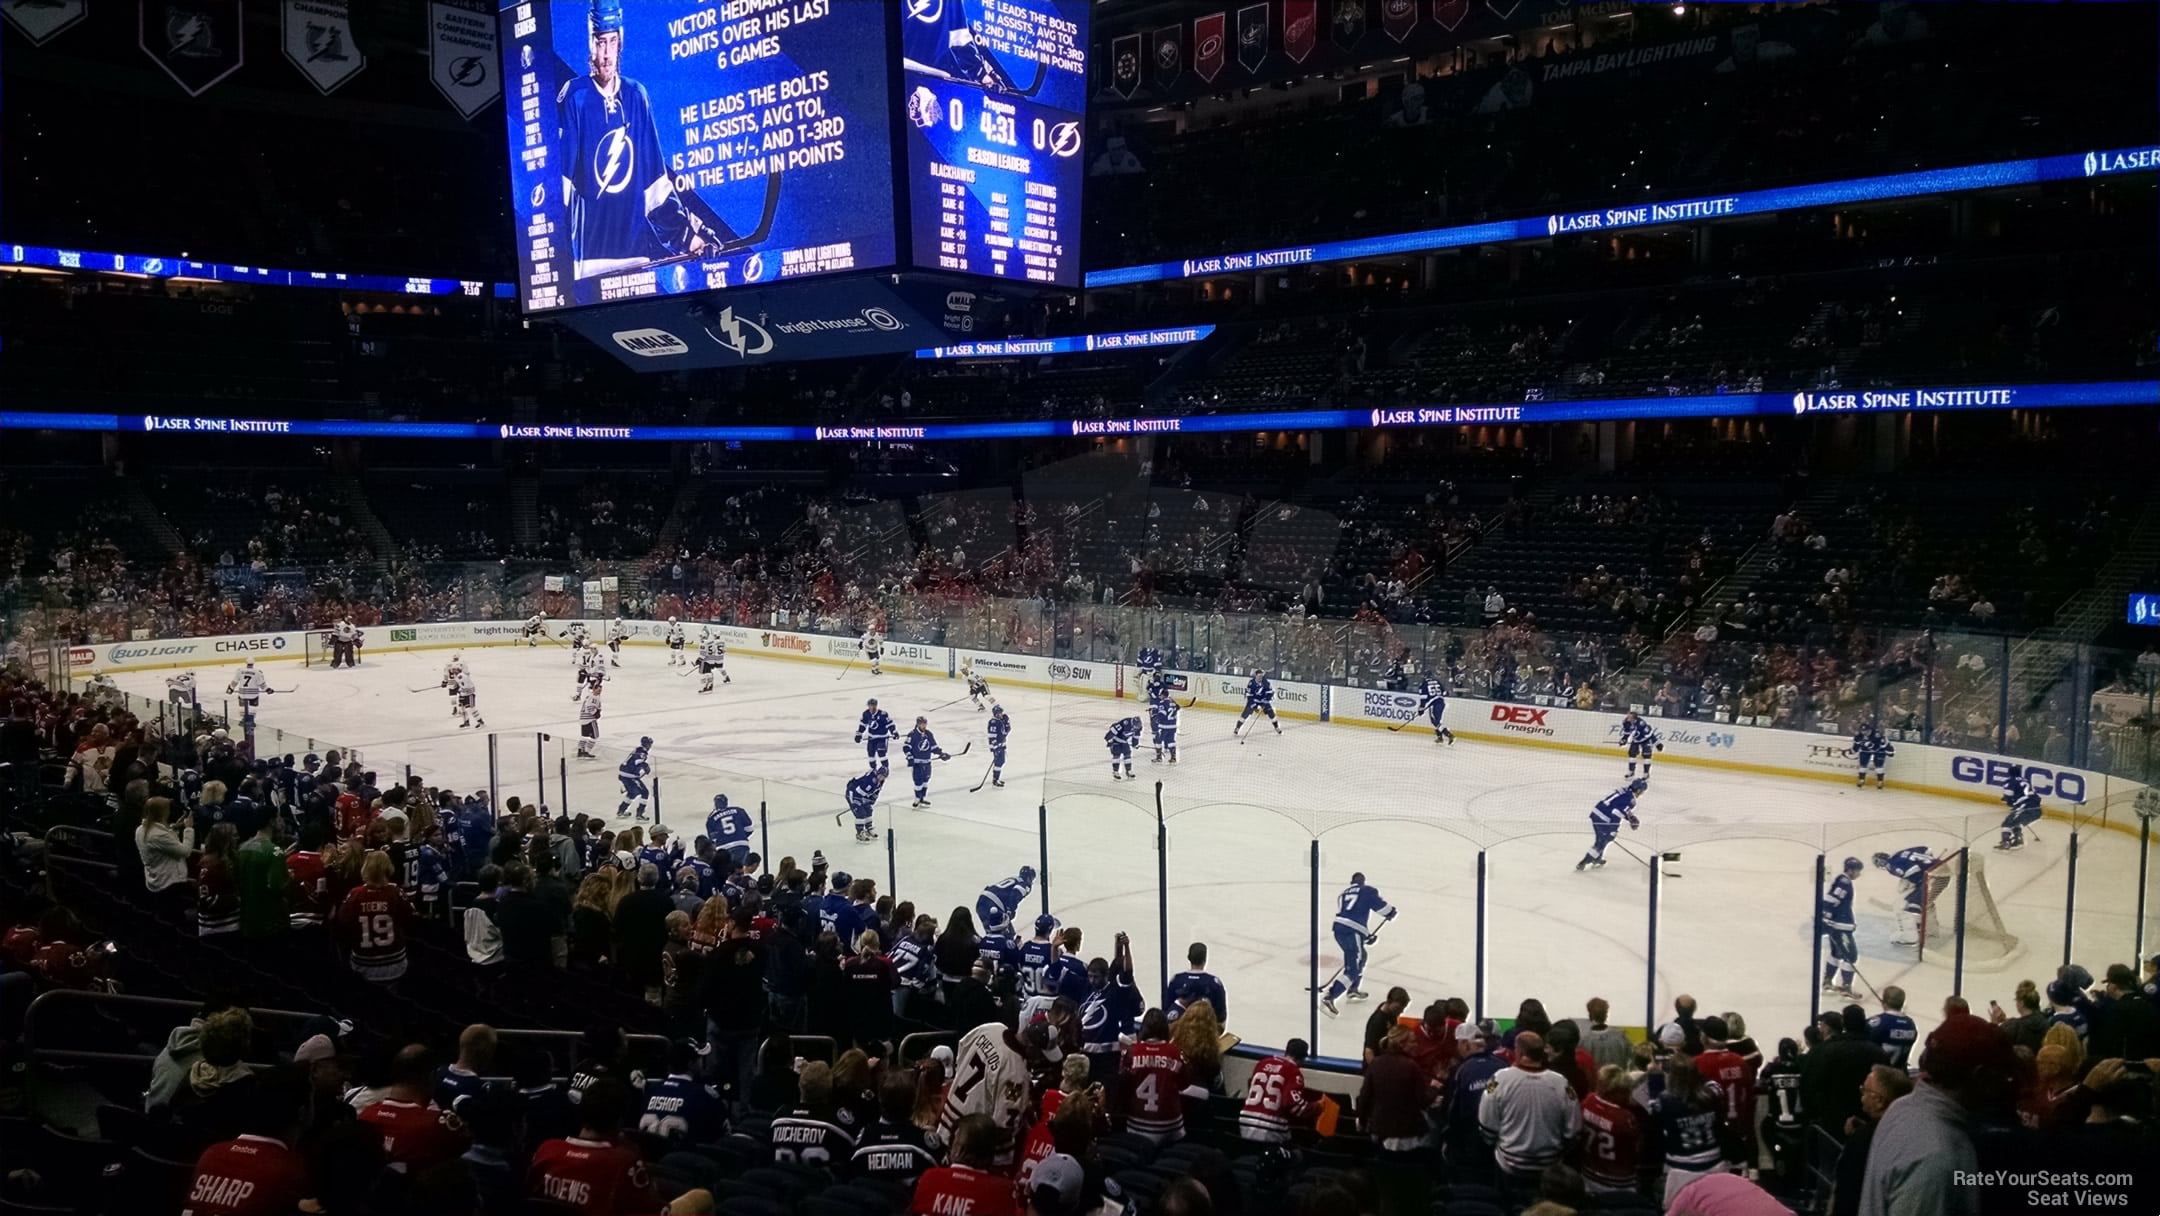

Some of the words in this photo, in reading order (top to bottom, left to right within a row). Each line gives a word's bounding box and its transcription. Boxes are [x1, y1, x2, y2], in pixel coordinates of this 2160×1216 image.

[446, 13, 485, 29] EASTERN
[668, 8, 717, 38] VICTOR
[981, 0, 995, 9] HE
[997, 1, 1027, 19] LEADS
[1029, 10, 1047, 25] THE
[1049, 17, 1078, 35] BOLTS
[437, 22, 494, 41] CONFERENCE
[671, 31, 719, 60] POINTS
[722, 18, 761, 45] OVER
[765, 9, 790, 32] HIS
[794, 0, 830, 24] LAST
[984, 10, 995, 22] IN
[997, 14, 1035, 36] ASSISTS,
[1037, 26, 1056, 41] AVG
[1058, 32, 1075, 48] TOI,
[440, 33, 491, 51] CHAMPIONS
[973, 20, 983, 32] IS
[985, 24, 1005, 38] 2ND
[1007, 30, 1017, 42] IN
[1036, 39, 1056, 53] AND
[1058, 45, 1085, 62] T-3RD
[717, 51, 727, 69] 6
[731, 35, 780, 66] GAMES
[974, 34, 990, 48] ON
[992, 38, 1010, 53] THE
[1013, 44, 1038, 61] TEAM
[1040, 52, 1050, 65] IN
[1051, 55, 1084, 74] POINTS
[1541, 58, 1592, 82] TAMPA
[1594, 53, 1624, 73] BAY
[1625, 35, 1718, 67] LIGHTNING
[680, 105, 698, 125] HE
[702, 93, 745, 120] LEADS
[748, 84, 776, 107] THE
[780, 70, 829, 100] BOLTS
[685, 127, 699, 146] IN
[703, 114, 759, 142] ASSISTS,
[762, 104, 793, 128] AVG
[795, 97, 825, 120] TOI,
[950, 98, 963, 131] 0
[980, 111, 1017, 146] 4:31
[1033, 118, 1045, 150] 0
[672, 153, 684, 171] IS
[688, 147, 714, 167] 2ND
[718, 142, 732, 159] IN
[735, 136, 759, 157] +/-,
[762, 128, 793, 151] AND
[797, 116, 844, 143] T-3RD
[675, 174, 695, 193] ON
[698, 166, 724, 187] THE
[727, 157, 766, 181] TEAM
[770, 153, 785, 173] IN
[789, 141, 844, 169] POINTS
[2101, 149, 2160, 171] LASER
[930, 162, 976, 184] BLACKHAWKS
[1559, 214, 1602, 231] LASER
[1606, 208, 1647, 226] SPINE
[1652, 198, 1734, 220] INSTITUTE
[13, 245, 24, 262] 0
[114, 254, 125, 271] 0
[1191, 259, 1221, 274] LASER
[1224, 255, 1253, 270] SPINE
[1256, 248, 1312, 266] INSTITUTE
[702, 261, 729, 271] Pregame
[707, 271, 727, 289] 4:31
[776, 320, 819, 335] bright
[820, 316, 868, 332] house
[621, 334, 681, 351] AMALIE
[946, 345, 974, 355] LASER
[976, 343, 1003, 354] SPINE
[1005, 341, 1053, 353] INSTITUTE
[1097, 336, 1122, 348] LASER
[1124, 334, 1148, 346] SPINE
[1150, 330, 1197, 343] INSTITUTE
[1807, 394, 1858, 410] LASER
[1863, 392, 1911, 408] SPINE
[1916, 389, 2011, 407] INSTITUTE
[154, 417, 191, 430] LASER
[194, 418, 227, 430] SPINE
[230, 419, 289, 432] INSTITUTE
[509, 425, 541, 437] LASER
[544, 426, 573, 437] SPINE
[576, 427, 630, 438] INSTITUTE
[822, 427, 849, 438] LASER
[850, 427, 875, 438] SPINE
[877, 427, 924, 438] INSTITUTE
[1079, 421, 1104, 433] LASER
[1106, 420, 1131, 432] SPINE
[1133, 419, 1180, 431] INSTITUTE
[392, 629, 416, 641] USF
[474, 627, 502, 635] bright
[115, 646, 148, 660] BUD
[150, 645, 199, 657] LIGHT
[215, 638, 269, 652] CHASE
[772, 633, 812, 653] DraftKings
[890, 644, 932, 660] JABIL
[975, 658, 1026, 670] MicroLumen
[1052, 664, 1066, 675] FOX
[1071, 667, 1092, 680] SUN
[243, 675, 252, 688] 7
[1277, 687, 1308, 702] Times
[1364, 693, 1392, 706] ROSE
[1364, 706, 1416, 721] RADIOLOGY
[1490, 704, 1550, 726] DEX
[1667, 728, 1701, 745] Blue
[1952, 756, 2087, 805] GECO
[720, 815, 736, 834] 5
[360, 901, 388, 912] TOEWS
[358, 913, 396, 948] 19
[975, 1034, 1000, 1072] CHELIOS
[954, 1052, 986, 1104] 7
[1136, 1073, 1159, 1112] 4
[1245, 1072, 1285, 1111] 65
[647, 1096, 685, 1113] BISHOP
[772, 1127, 826, 1145] KUCHEROV
[868, 1152, 913, 1170] HEDMAN
[190, 1174, 255, 1208] SHARP
[544, 1173, 591, 1206] TOEWS
[932, 1192, 976, 1216] KANE
